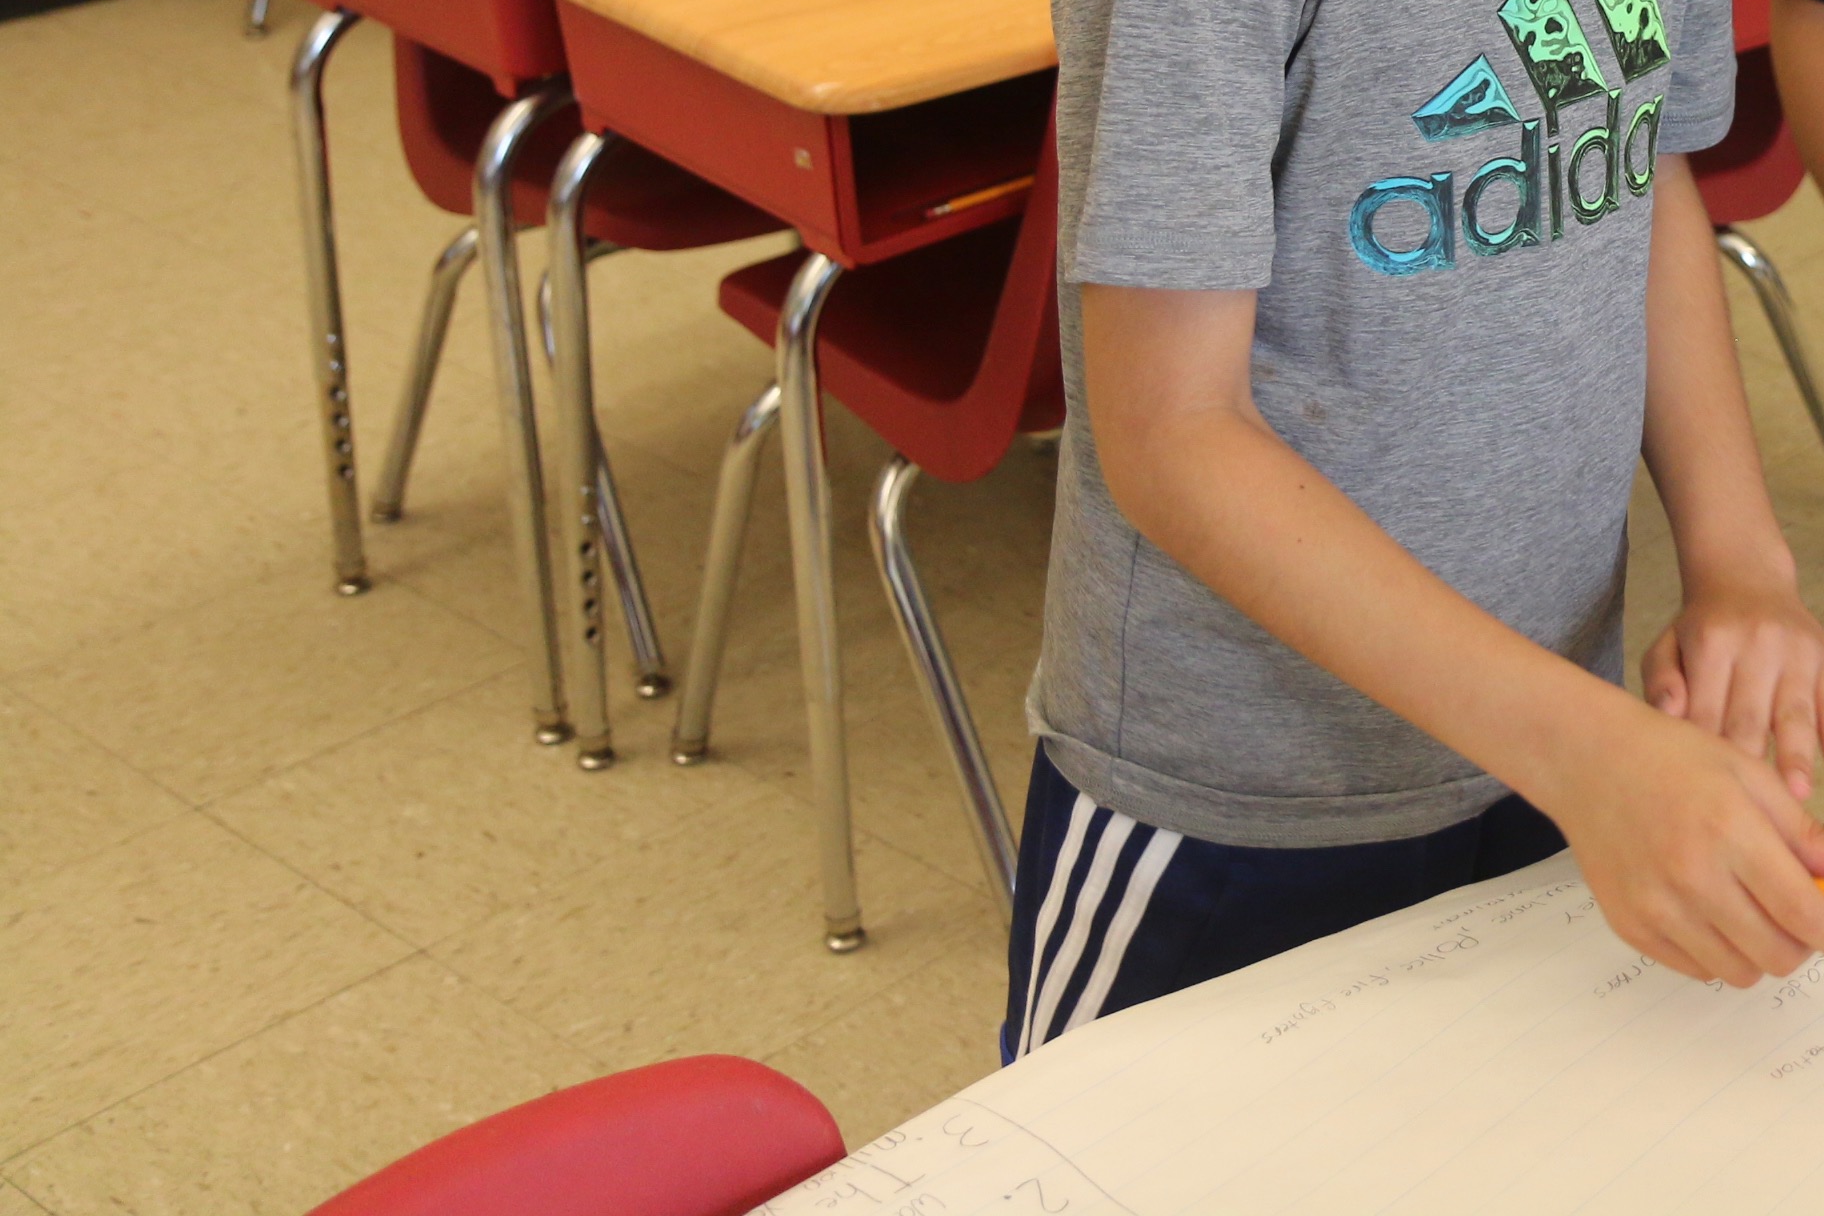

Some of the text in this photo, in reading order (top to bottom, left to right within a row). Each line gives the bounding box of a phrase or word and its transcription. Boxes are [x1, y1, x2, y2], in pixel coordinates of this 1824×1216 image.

[1347, 88, 1664, 277] adida
[1593, 953, 1658, 999] orkers
[917, 1114, 990, 1148] 3.
[815, 1163, 927, 1208] The
[1002, 1178, 1070, 1214] 2.
